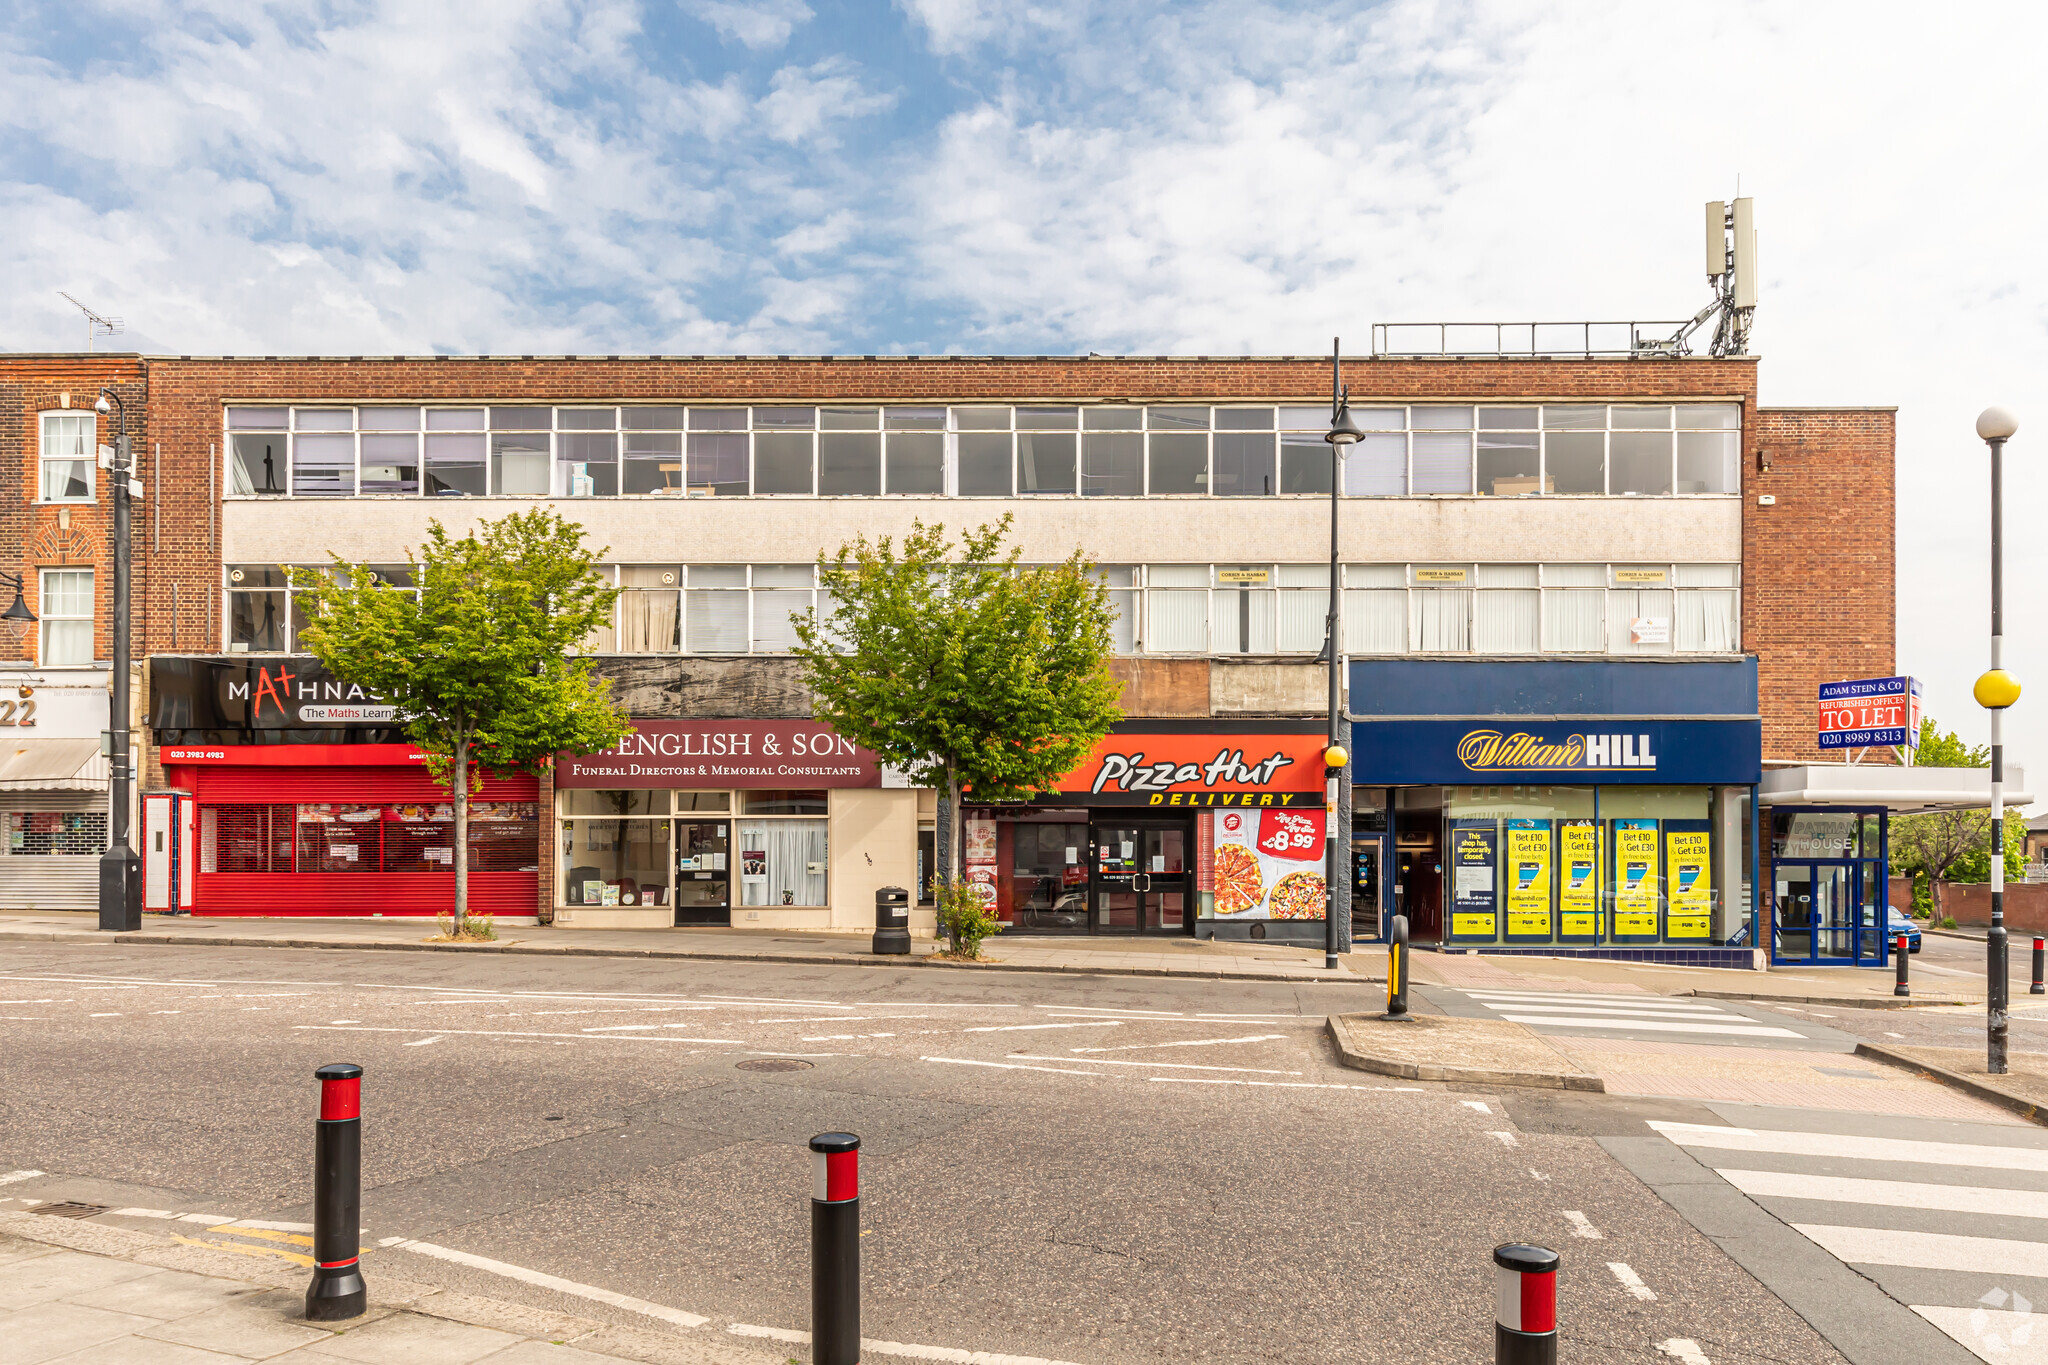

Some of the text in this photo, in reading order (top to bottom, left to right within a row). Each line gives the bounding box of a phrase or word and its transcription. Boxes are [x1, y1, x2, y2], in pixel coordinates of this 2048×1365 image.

[1822, 686, 1849, 696] ADAM
[1851, 684, 1876, 694] STEIN
[1878, 683, 1886, 692] &
[1820, 696, 1904, 710] REFURBISHED OFFICES
[305, 709, 324, 718] The
[328, 709, 360, 718] Maths
[1823, 706, 1902, 729] TO LET
[1822, 730, 1901, 744] 020 8989 8313
[762, 733, 784, 756] &
[792, 733, 857, 756] SON
[1457, 730, 1656, 768] William HILL
[698, 765, 707, 776] &
[1091, 748, 1294, 794] Pizza Hut
[1150, 794, 1294, 805] DELIVERY
[1274, 812, 1292, 823] Any
[1284, 822, 1300, 832] Any
[1794, 822, 1857, 834] PATMAN
[1571, 842, 1584, 850] Get
[1800, 838, 1852, 850] HOUSE
[1678, 847, 1691, 855] Get
